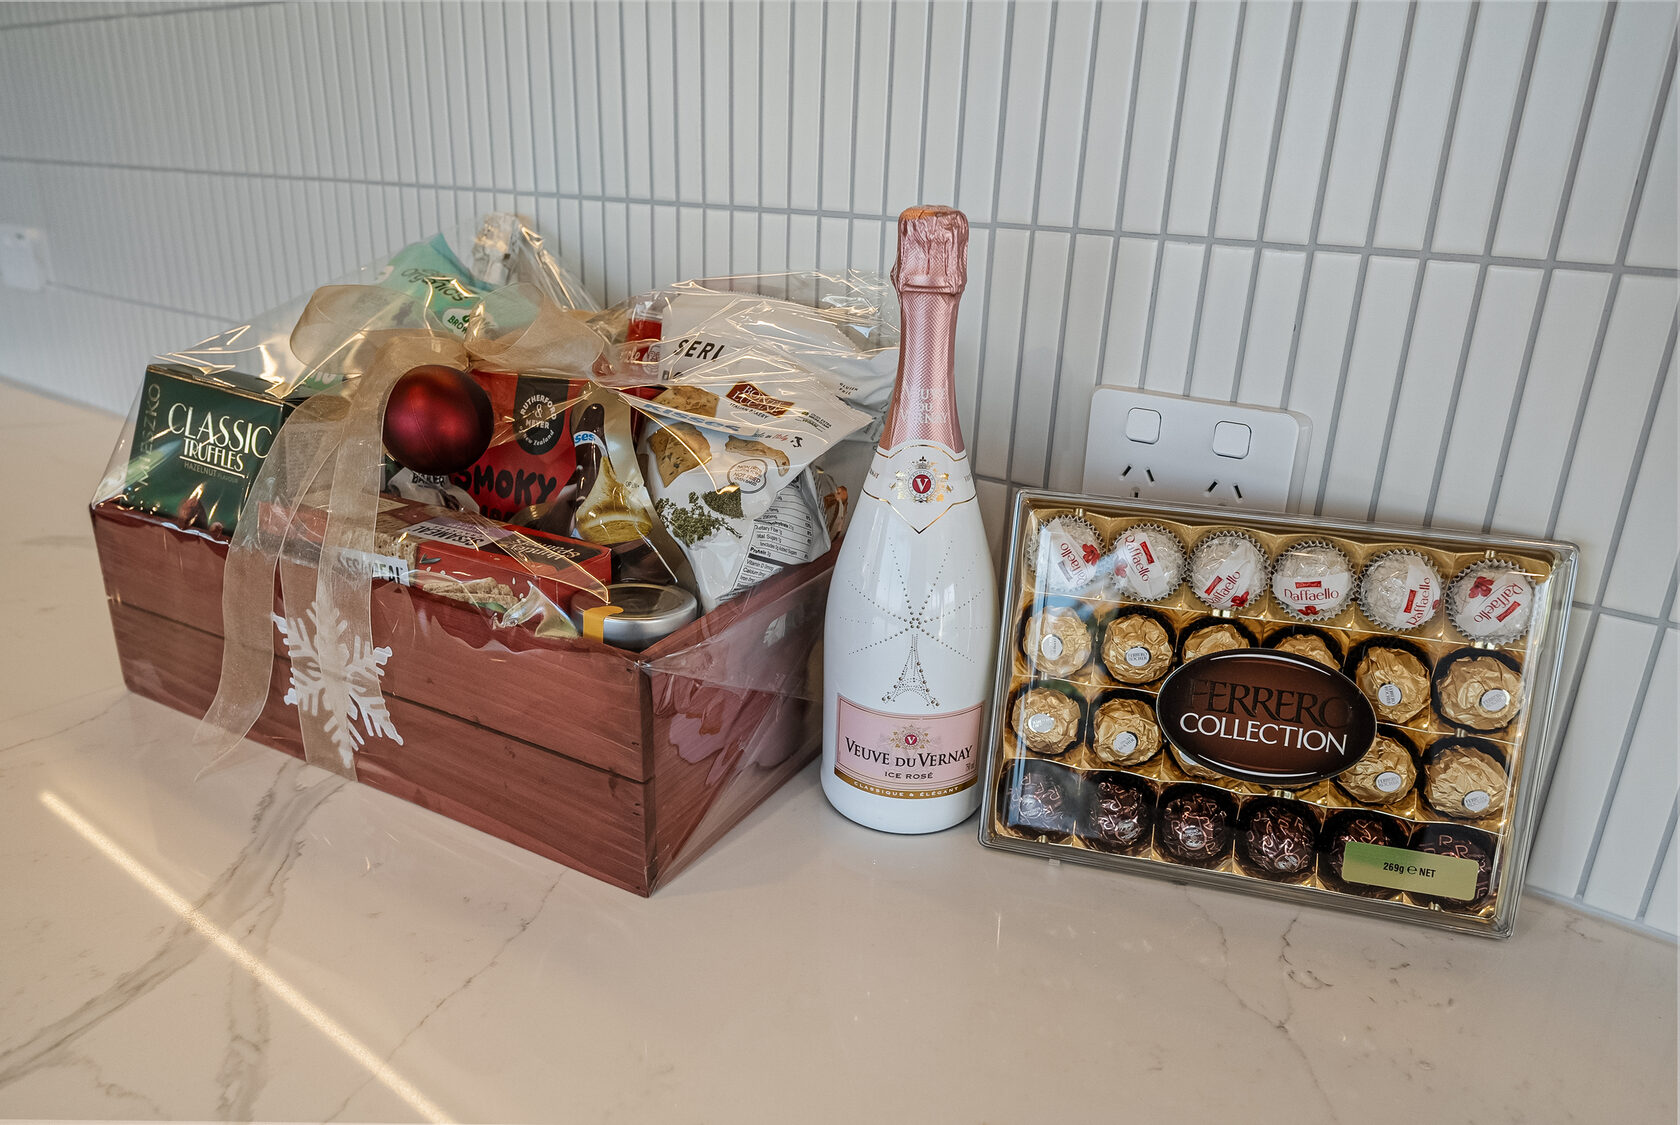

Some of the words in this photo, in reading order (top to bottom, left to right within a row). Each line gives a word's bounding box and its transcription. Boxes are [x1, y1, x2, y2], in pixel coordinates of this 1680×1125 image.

[520, 394, 557, 420] RUTHERFORD
[534, 403, 543, 418] &
[168, 402, 273, 459] CLASSIC
[525, 419, 550, 429] MEYER
[183, 438, 244, 472] TRUFFLES
[184, 461, 218, 477] HAZELNUT
[455, 465, 557, 506] SMOKY
[915, 478, 929, 492] V
[1124, 534, 1151, 583] Raffaello
[1207, 571, 1241, 606] Raffaello
[1284, 588, 1340, 602] Raffaello
[1406, 576, 1431, 627] Raffaello
[1473, 583, 1525, 623] Raffaello
[1188, 678, 1349, 729] FERRERO
[906, 736, 917, 745] V
[1179, 712, 1348, 756] COLLECTION
[845, 736, 890, 766] VEUVE
[895, 756, 917, 768] DU
[917, 745, 973, 768] VERNAY
[853, 781, 905, 797] CLASSIQUE
[919, 786, 960, 797] ÉLÉGANT
[884, 771, 902, 779] ICE
[905, 771, 934, 780] ROSÉ
[1383, 862, 1405, 875] 269g
[1419, 867, 1437, 878] NET
